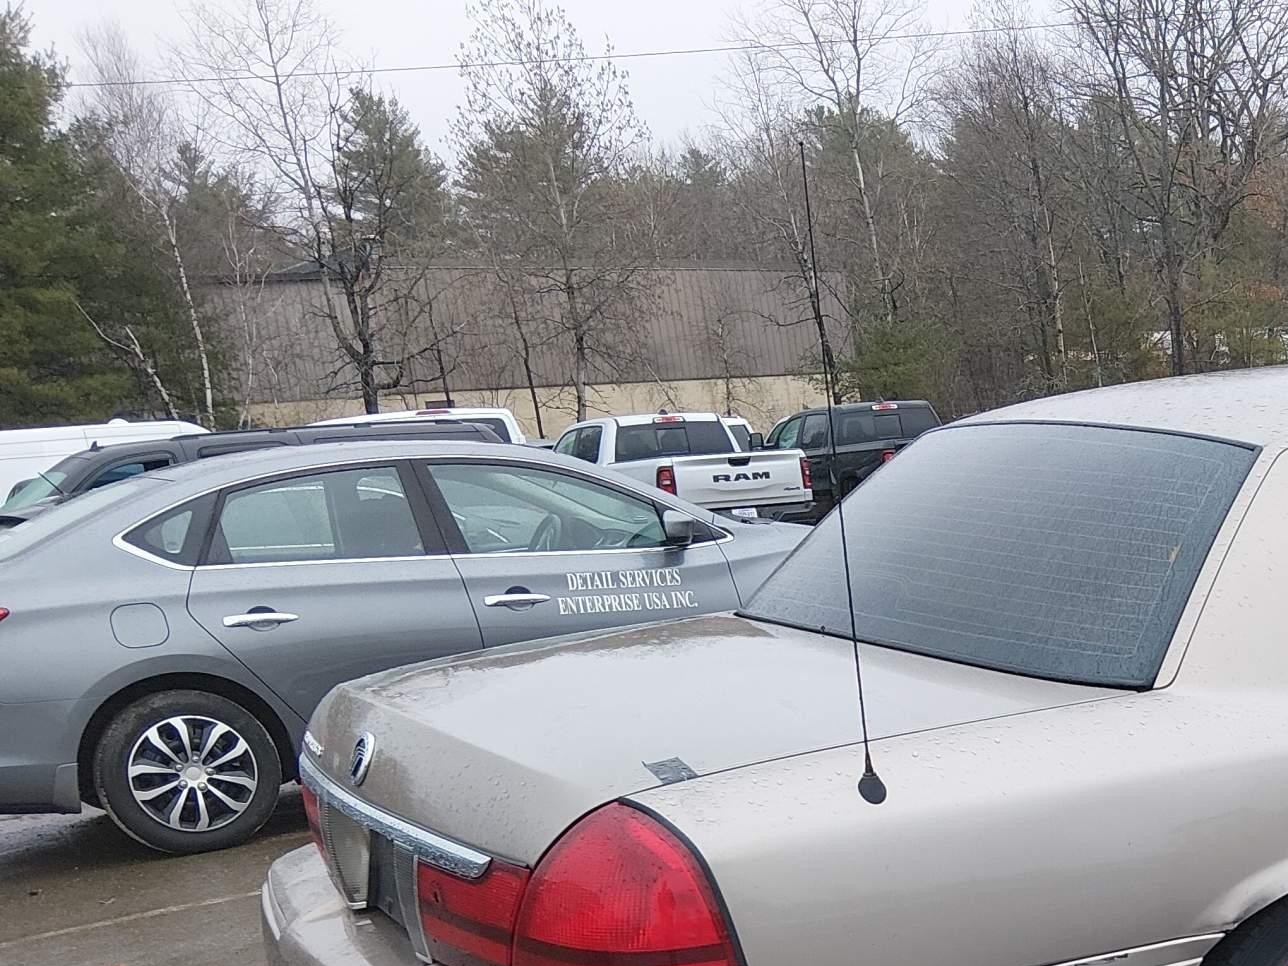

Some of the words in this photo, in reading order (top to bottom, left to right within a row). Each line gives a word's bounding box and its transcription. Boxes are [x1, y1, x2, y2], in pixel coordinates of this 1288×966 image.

[712, 471, 771, 483] RAM
[566, 571, 617, 591] DETAIL
[619, 568, 681, 588] SERVICES
[557, 593, 641, 615] ENTERPRISE
[643, 591, 670, 610] USA
[671, 590, 699, 609] INC.
